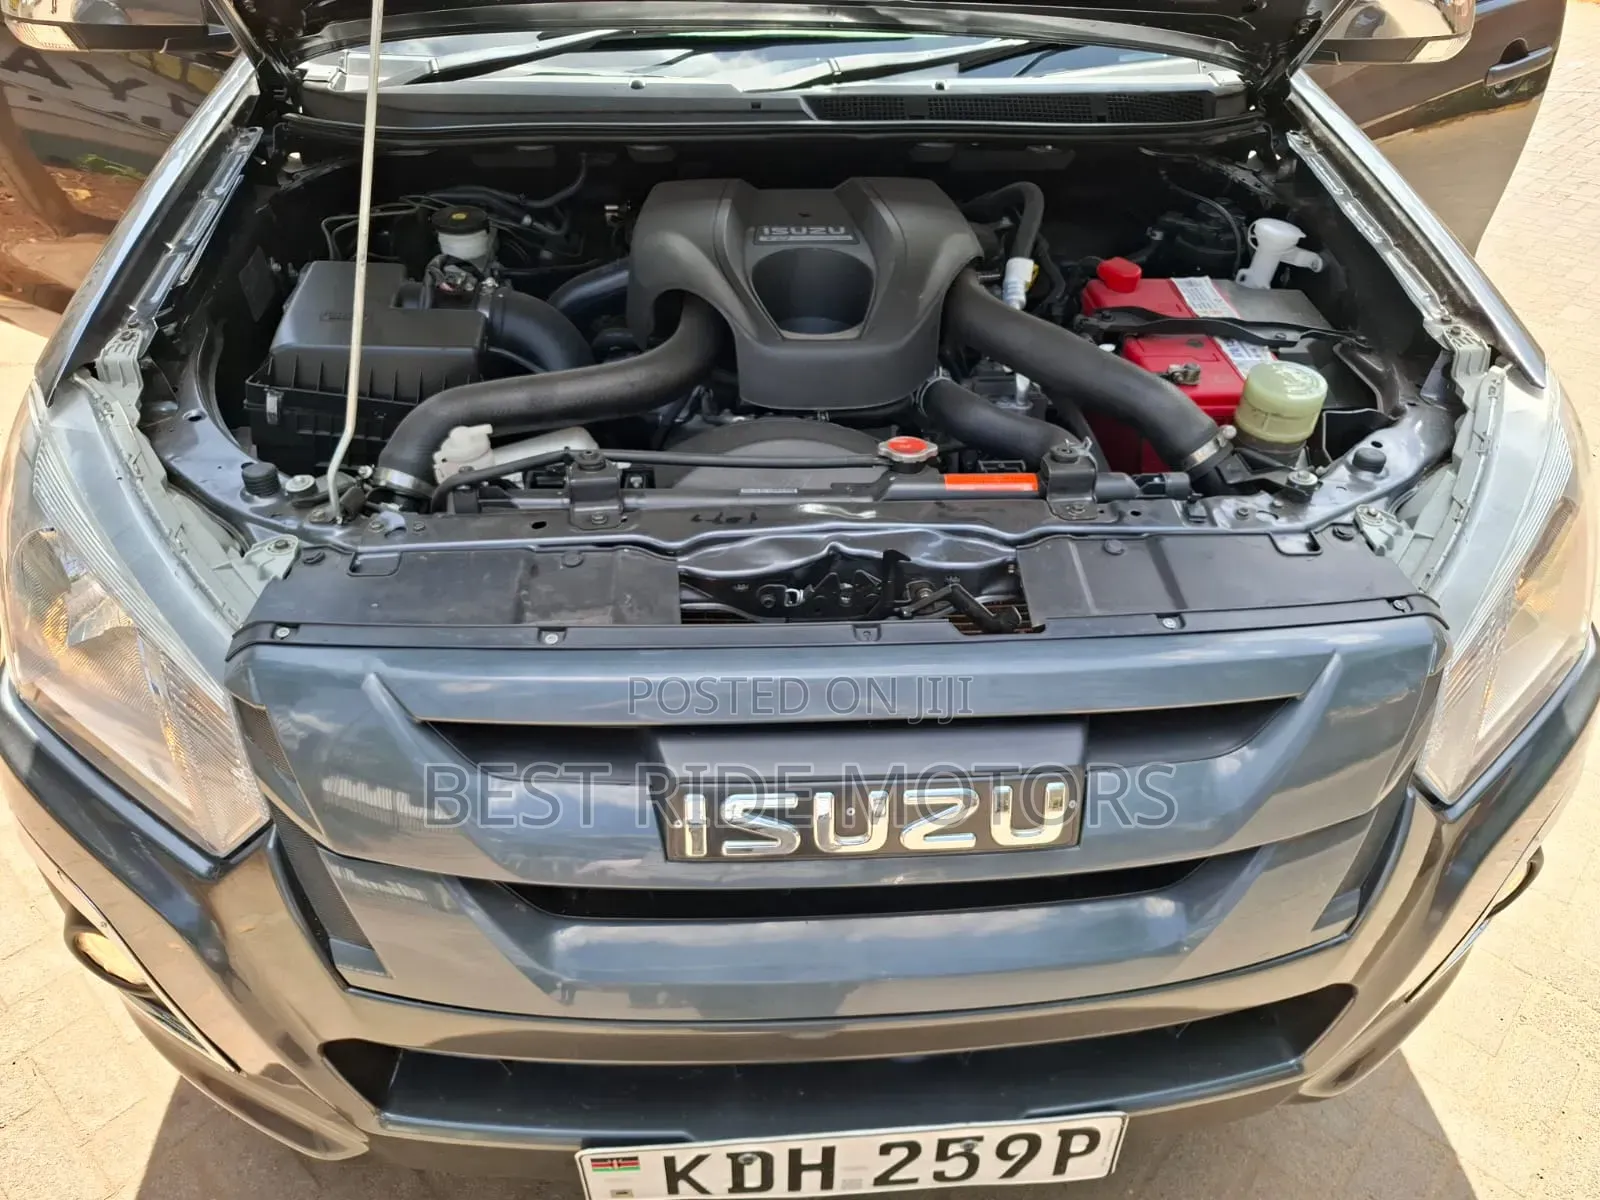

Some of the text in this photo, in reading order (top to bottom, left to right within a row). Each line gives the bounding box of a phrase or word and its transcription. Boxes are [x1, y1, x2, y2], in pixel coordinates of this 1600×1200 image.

[763, 226, 846, 236] ISUZU
[684, 782, 1066, 856] ISUZU
[663, 1145, 836, 1195] KDH
[872, 1127, 1102, 1187] 259P
